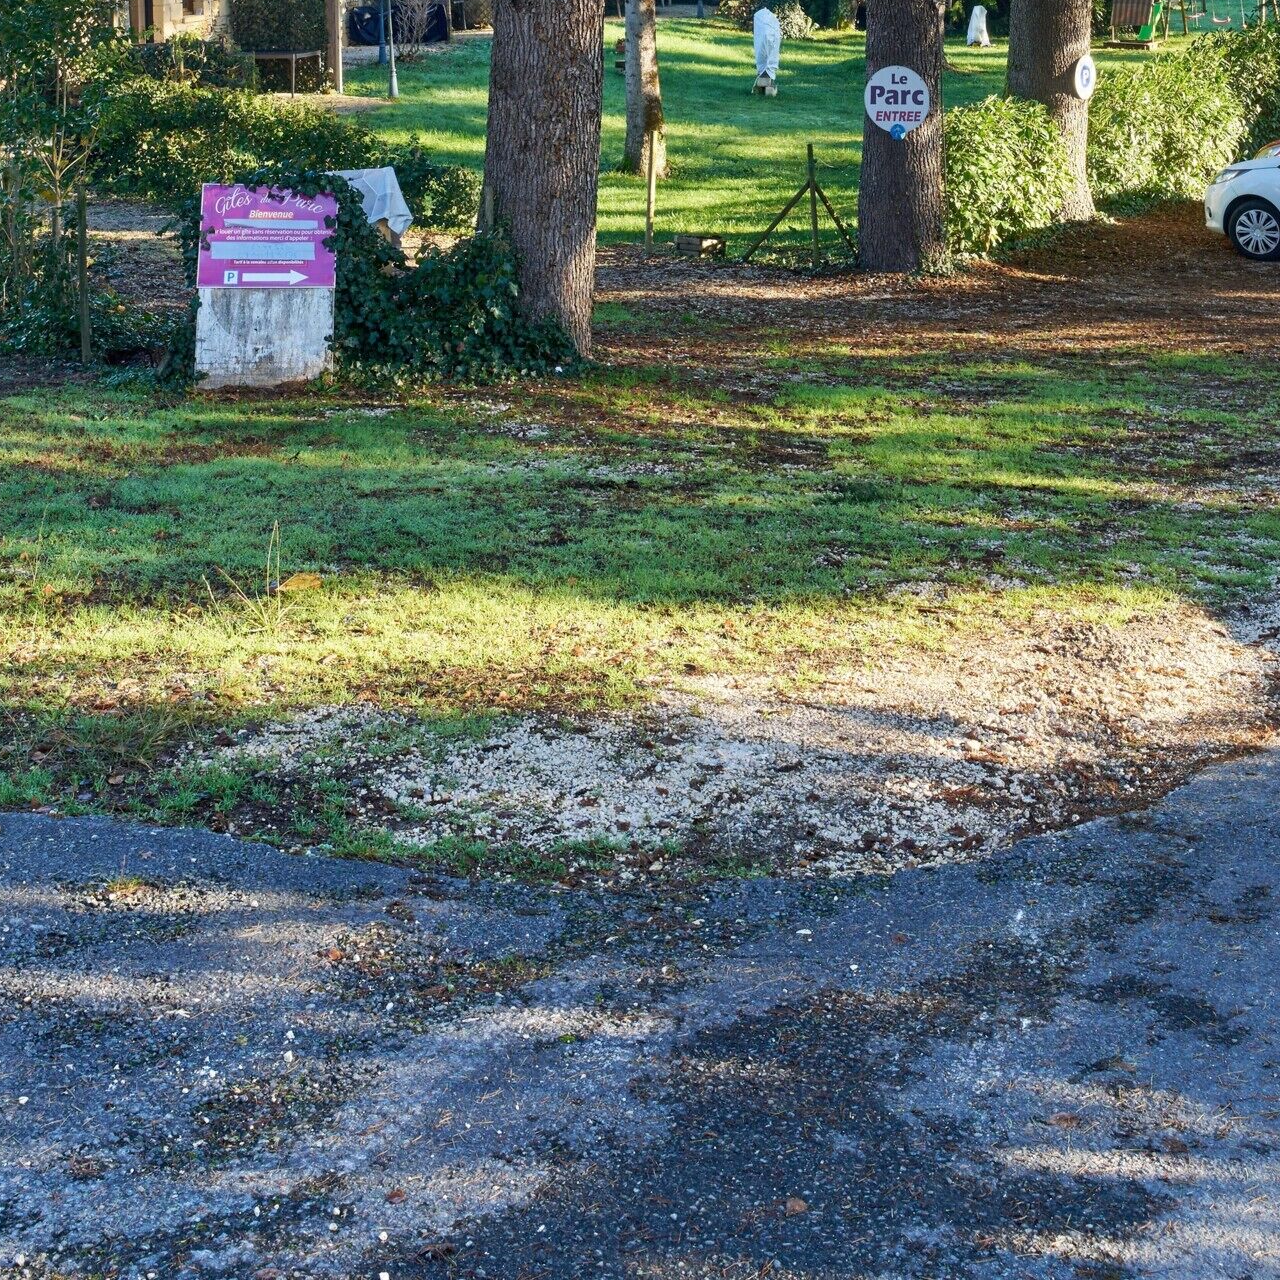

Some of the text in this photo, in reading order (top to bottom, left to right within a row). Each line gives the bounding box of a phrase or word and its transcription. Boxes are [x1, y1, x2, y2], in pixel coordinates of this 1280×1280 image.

[891, 73, 908, 85] Le
[870, 85, 924, 105] Parc
[876, 111, 921, 122] ENTREE
[215, 187, 253, 217] Gîtes
[249, 210, 294, 218] Bienvenue
[227, 272, 235, 282] P
